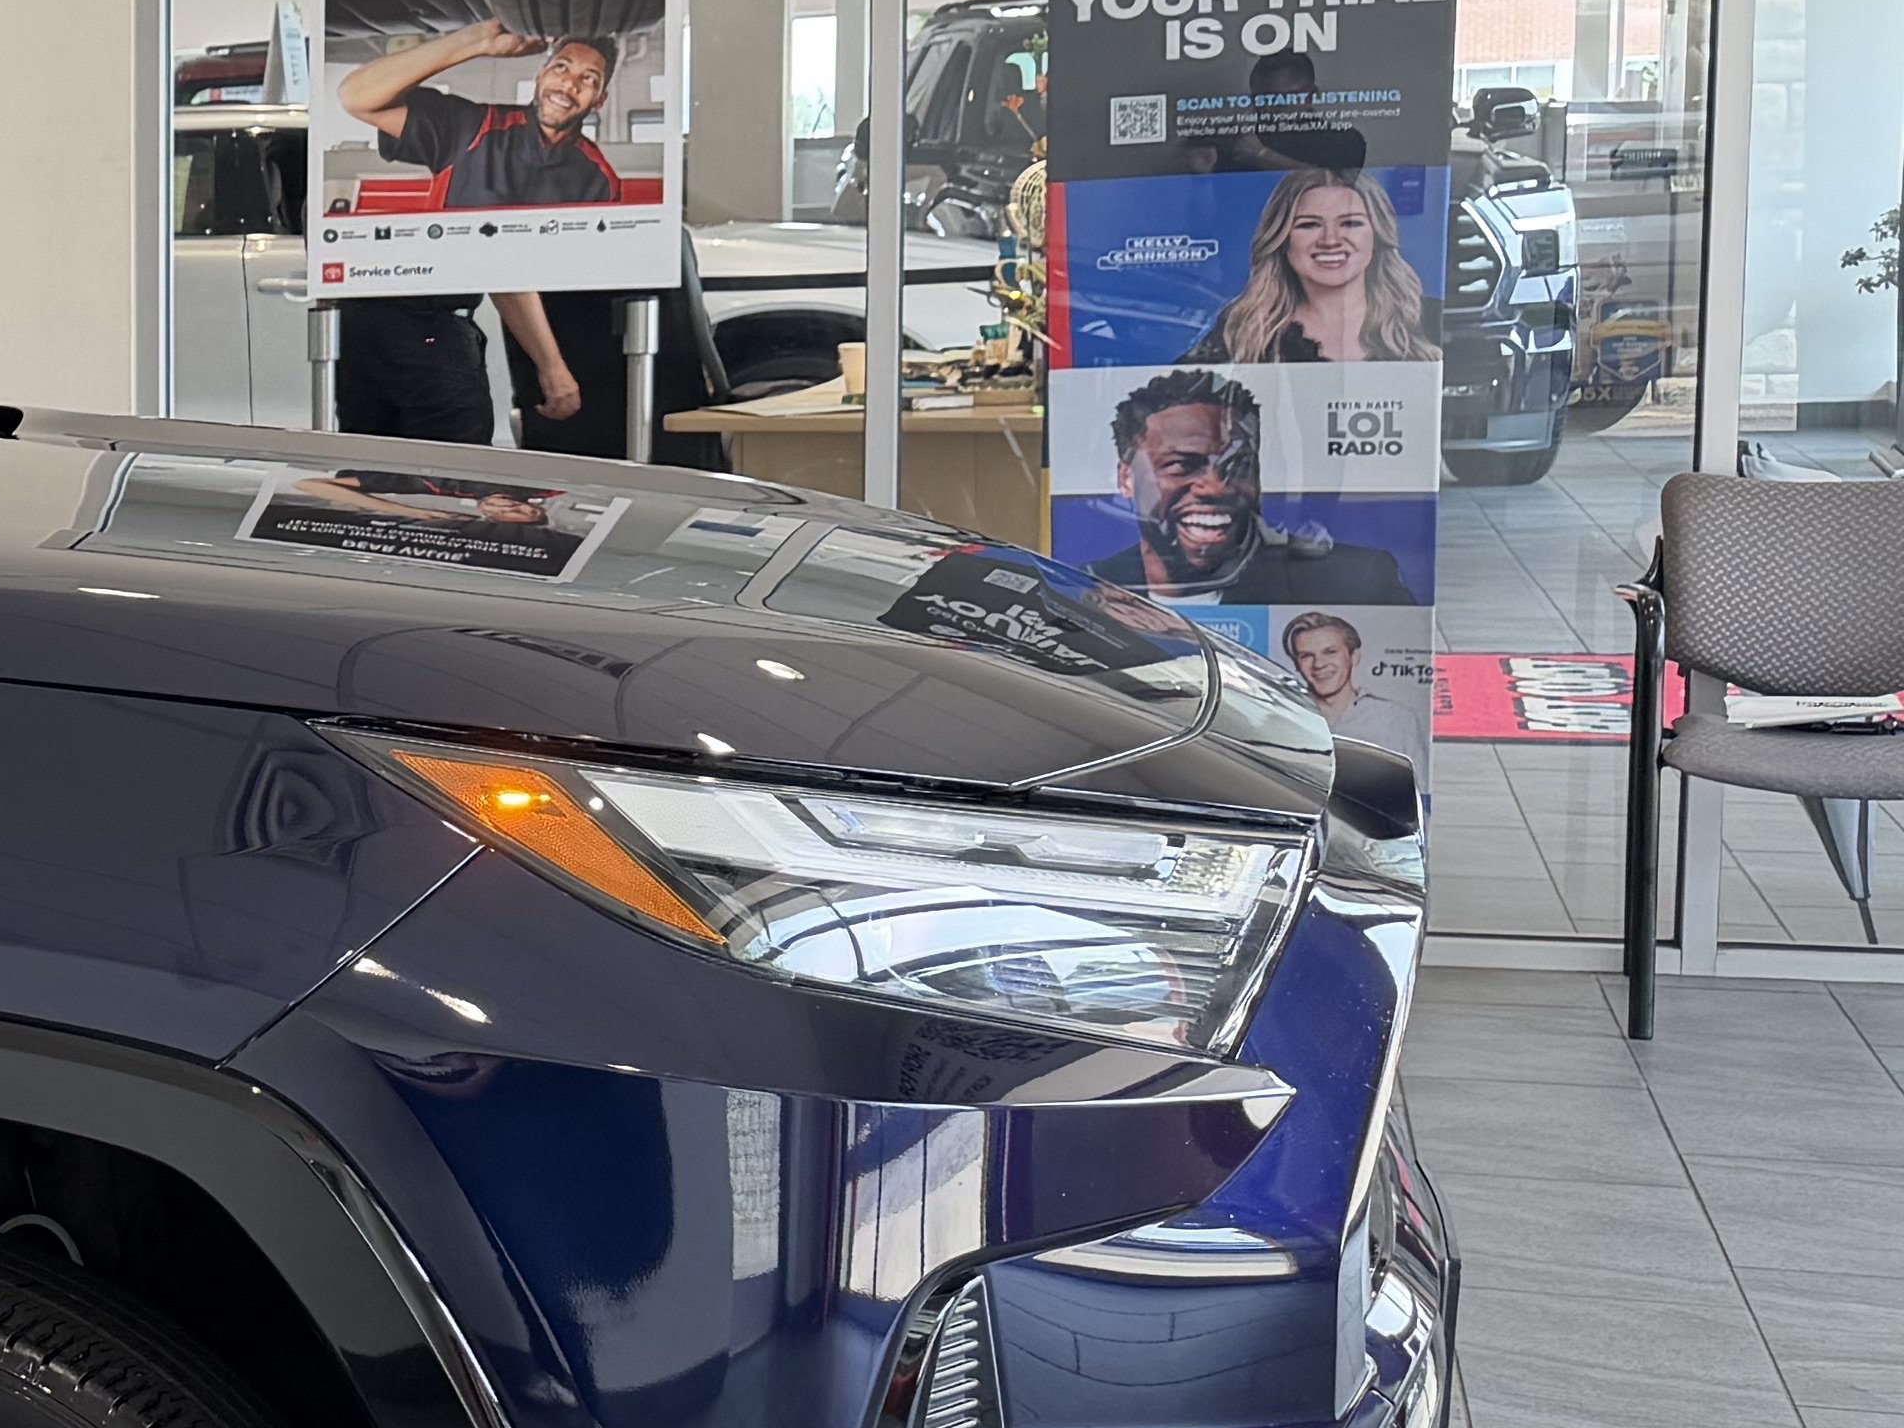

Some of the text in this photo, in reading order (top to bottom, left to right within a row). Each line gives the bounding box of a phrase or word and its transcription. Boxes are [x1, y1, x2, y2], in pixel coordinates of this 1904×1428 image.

[1165, 10, 1338, 61] IS ON
[1176, 89, 1402, 111] SCAN TO START LISTENING
[1177, 114, 1208, 126] Enjoy
[349, 263, 434, 278] Service Center
[1327, 411, 1403, 439] LOL
[1390, 664, 1433, 677] TikTo
